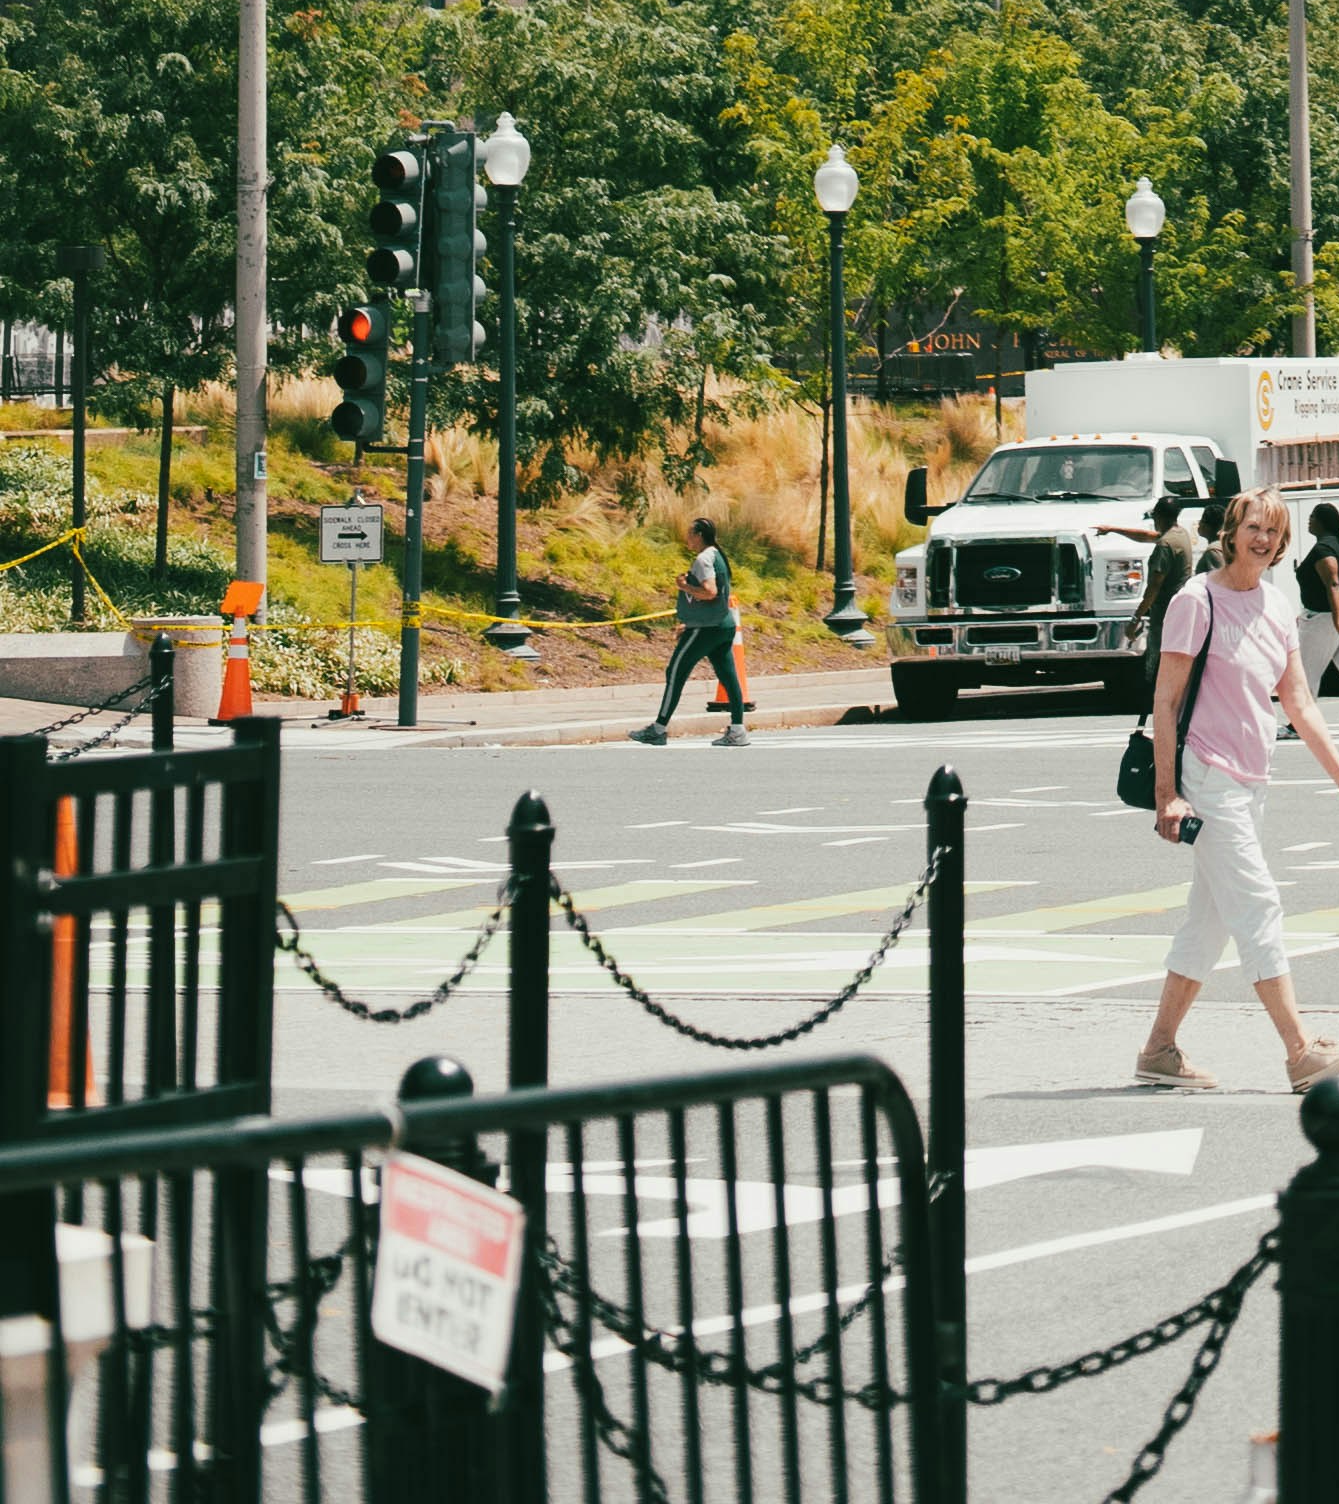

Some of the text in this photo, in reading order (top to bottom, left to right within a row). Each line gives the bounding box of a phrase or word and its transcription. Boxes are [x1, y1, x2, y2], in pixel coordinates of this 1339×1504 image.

[926, 332, 982, 352] JOHN
[1277, 369, 1303, 391] Crane
[1306, 369, 1338, 391] Service
[1294, 398, 1319, 418] Rigging
